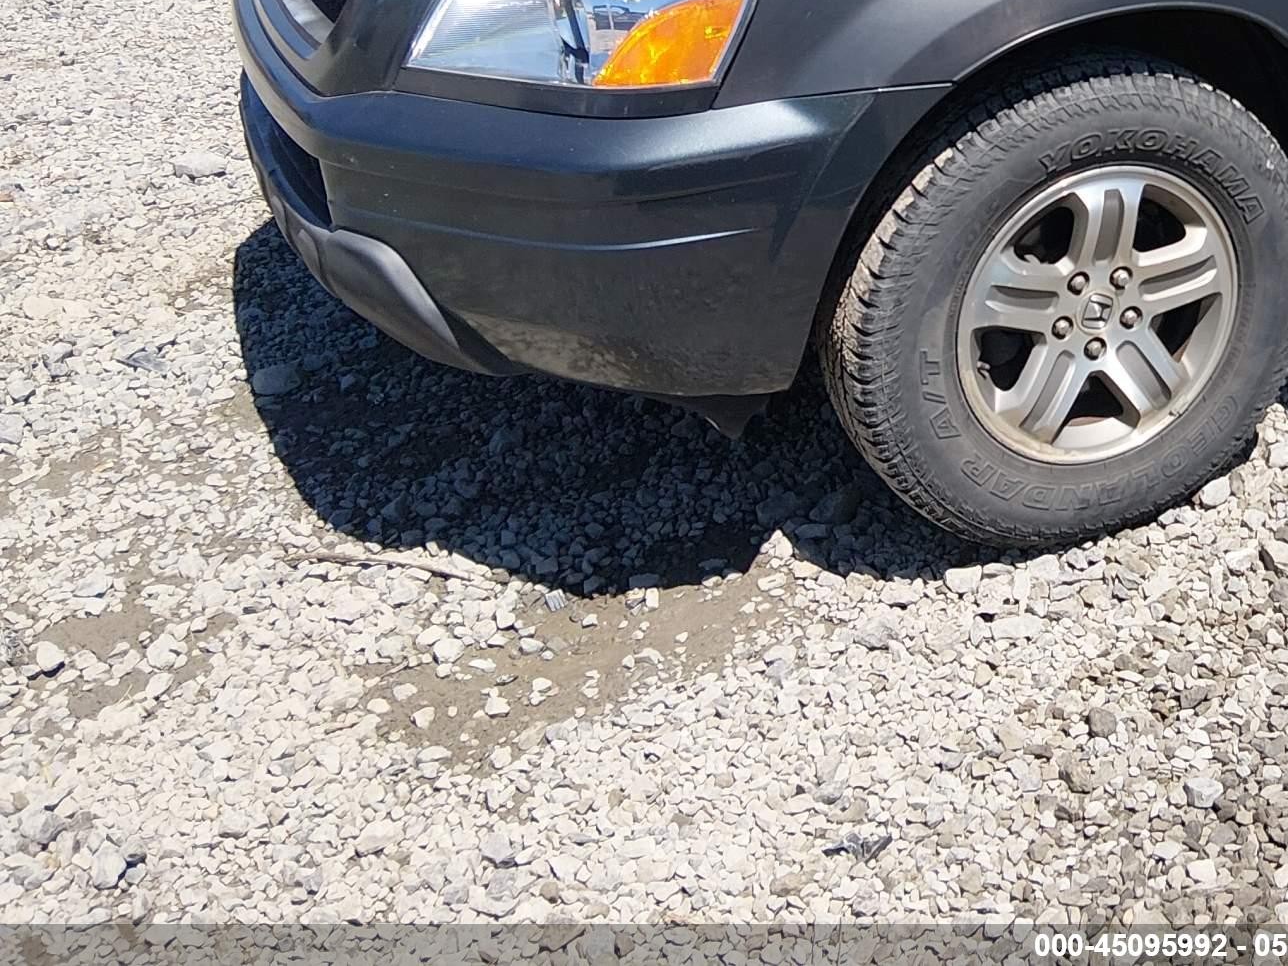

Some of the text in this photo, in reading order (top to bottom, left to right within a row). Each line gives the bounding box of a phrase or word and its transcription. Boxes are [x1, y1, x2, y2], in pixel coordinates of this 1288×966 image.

[1038, 127, 1267, 225] YOKOHAMA
[919, 347, 963, 440] A/T
[959, 393, 1243, 512] GEOLANDAR
